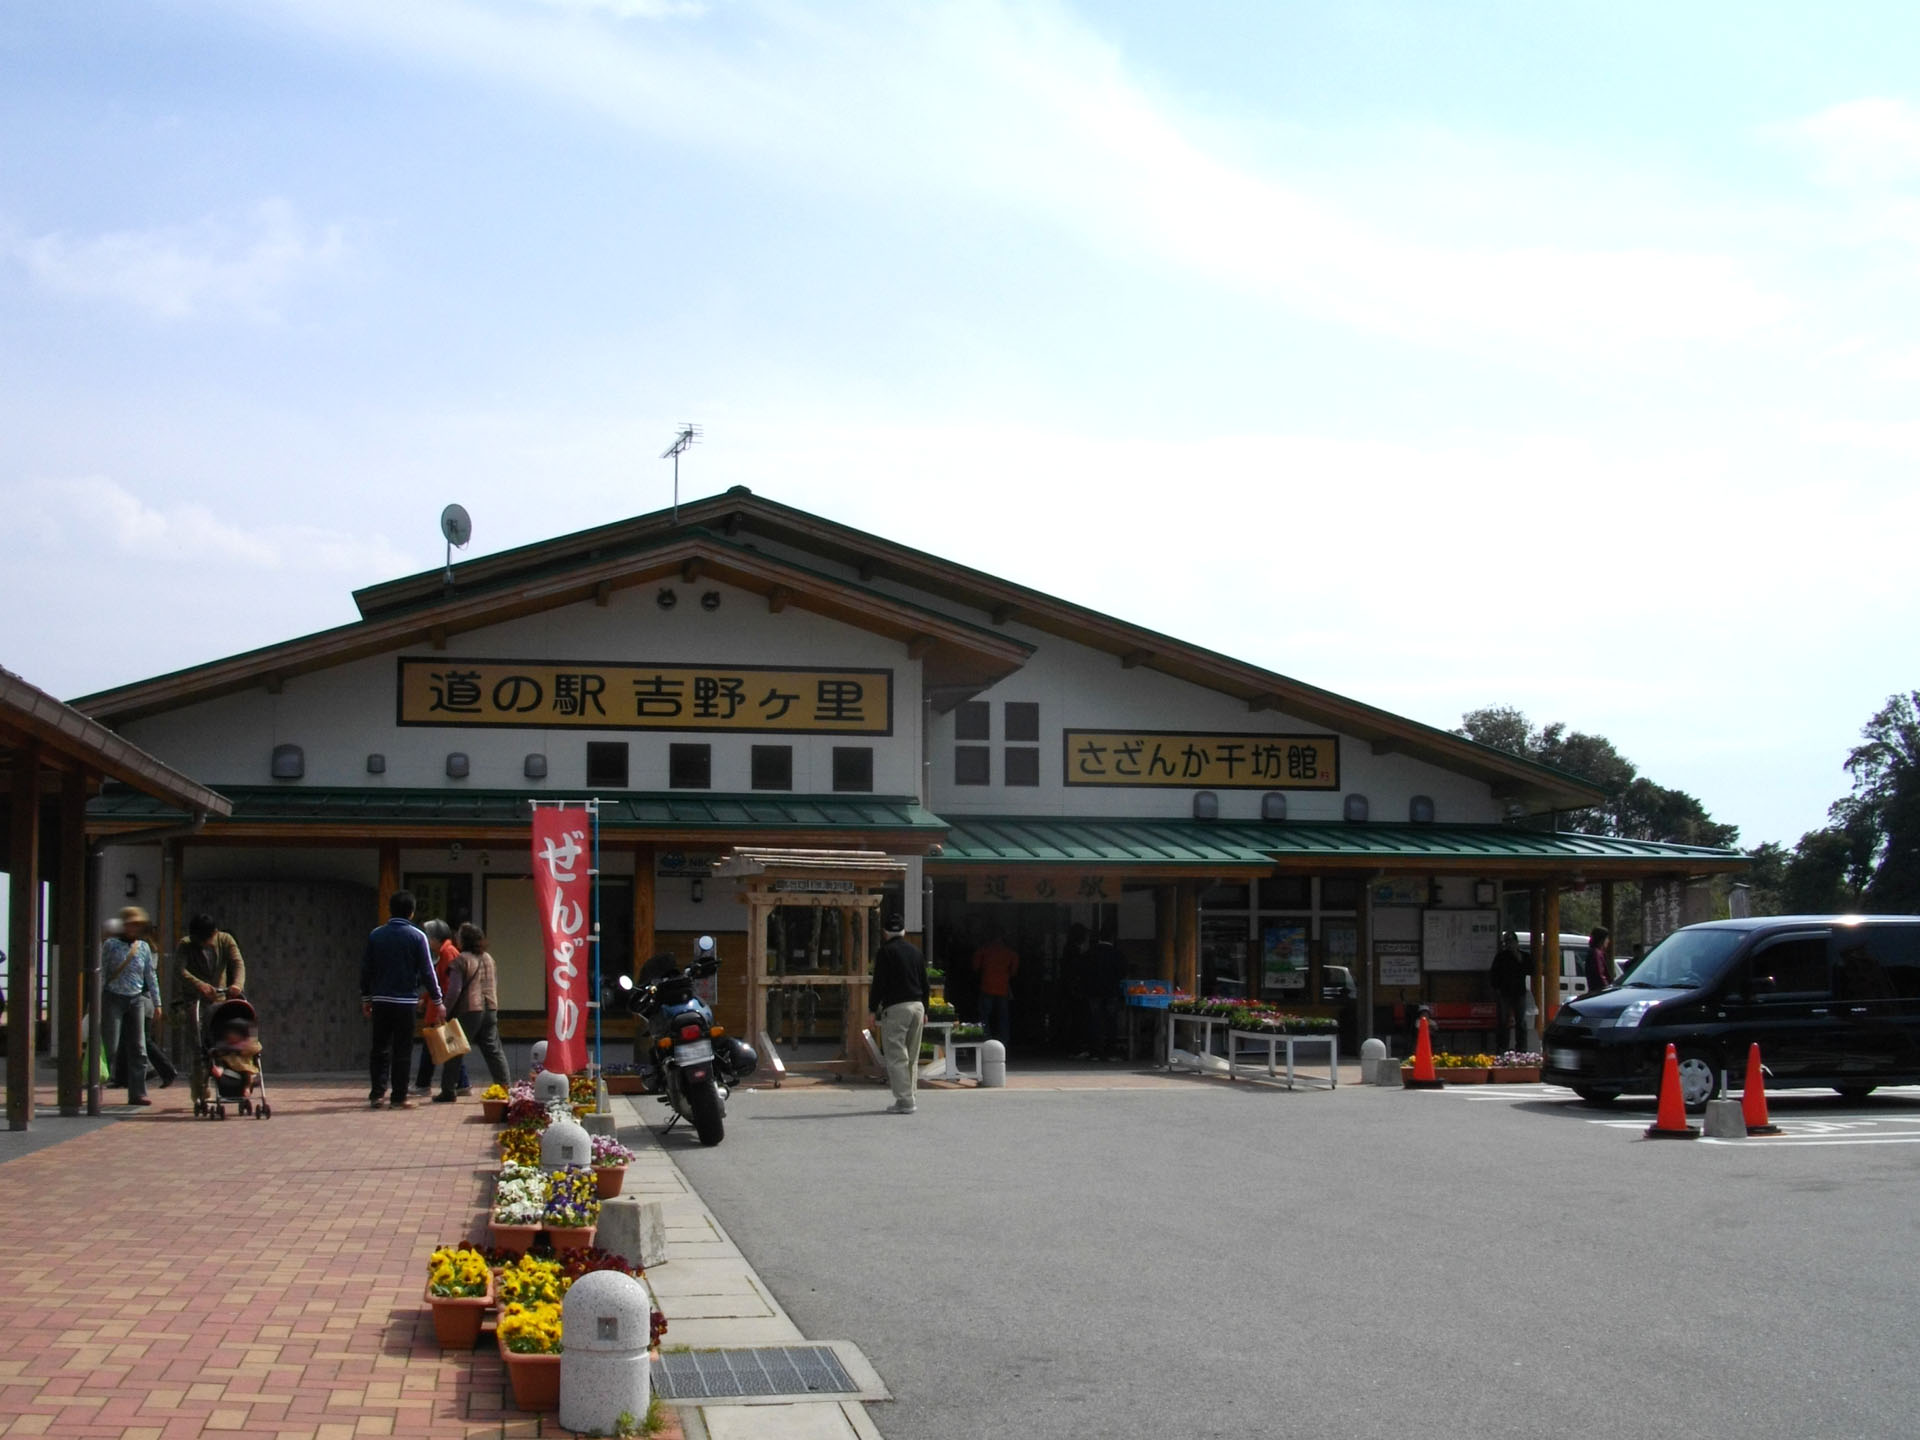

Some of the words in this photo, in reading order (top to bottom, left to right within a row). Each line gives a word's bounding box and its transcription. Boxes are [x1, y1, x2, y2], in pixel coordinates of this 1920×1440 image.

[429, 671, 607, 717] 道の駅
[538, 830, 584, 1042] ぜんざい
